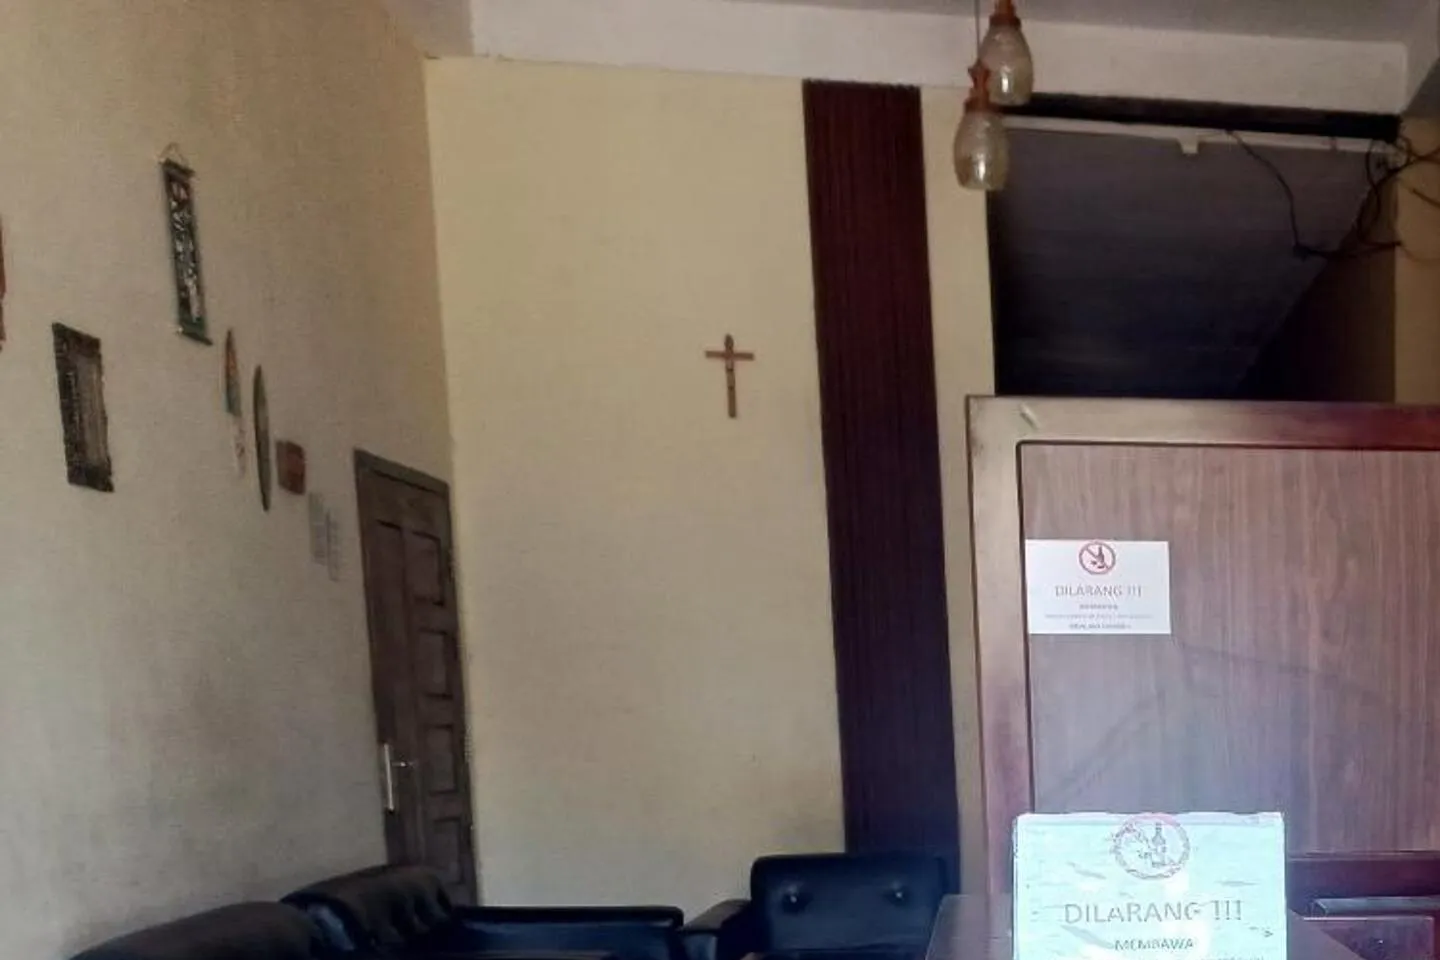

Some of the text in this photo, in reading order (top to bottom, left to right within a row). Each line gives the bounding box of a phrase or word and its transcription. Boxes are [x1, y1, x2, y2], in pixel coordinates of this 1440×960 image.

[1054, 584, 1122, 597] DILARANG
[1064, 900, 1242, 924] DILARANG !!!
